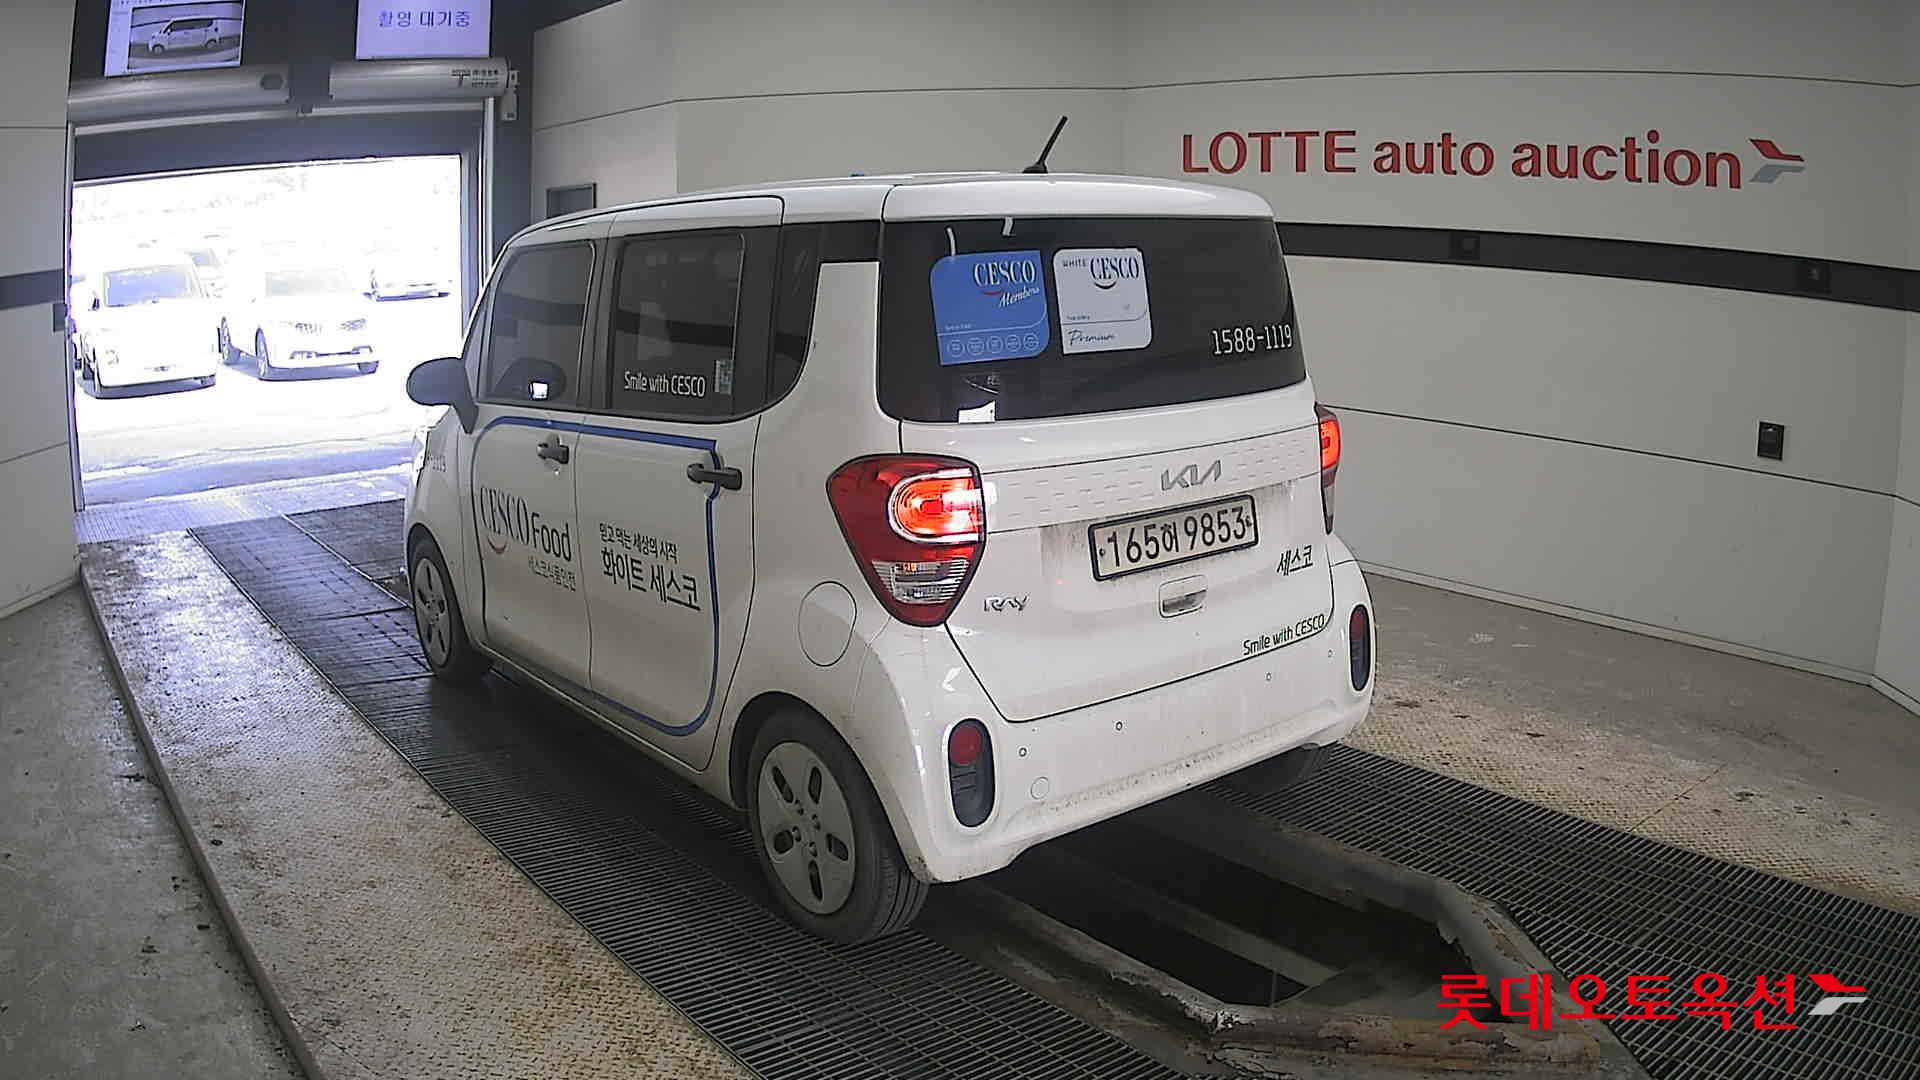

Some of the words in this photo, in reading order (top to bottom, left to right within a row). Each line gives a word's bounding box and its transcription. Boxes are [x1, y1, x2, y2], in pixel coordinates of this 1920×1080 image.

[419, 10, 471, 28] 대기중
[1182, 129, 1357, 174] LOTTE
[1373, 131, 1495, 177] auto
[1511, 129, 1742, 190] auction
[973, 260, 1037, 287] CESCO
[1063, 259, 1088, 268] WHITE
[1089, 256, 1140, 281] CESCO
[999, 286, 1041, 308] Members
[1212, 323, 1292, 355] 1588-1119
[623, 370, 648, 392] Smile
[648, 373, 669, 393] with
[670, 375, 706, 397] CESCO
[1160, 459, 1222, 491] KIA
[480, 485, 530, 546] CESCO
[531, 511, 572, 562] Food
[632, 532, 659, 558] 세상의
[659, 540, 679, 565] 시작
[1276, 544, 1313, 576] 세스코
[600, 546, 647, 592] 화이트
[649, 563, 701, 611] 세스코
[983, 594, 1028, 612] RAY
[1243, 634, 1271, 656] Smile
[1271, 625, 1294, 646] with
[1295, 613, 1325, 637] CESCO
